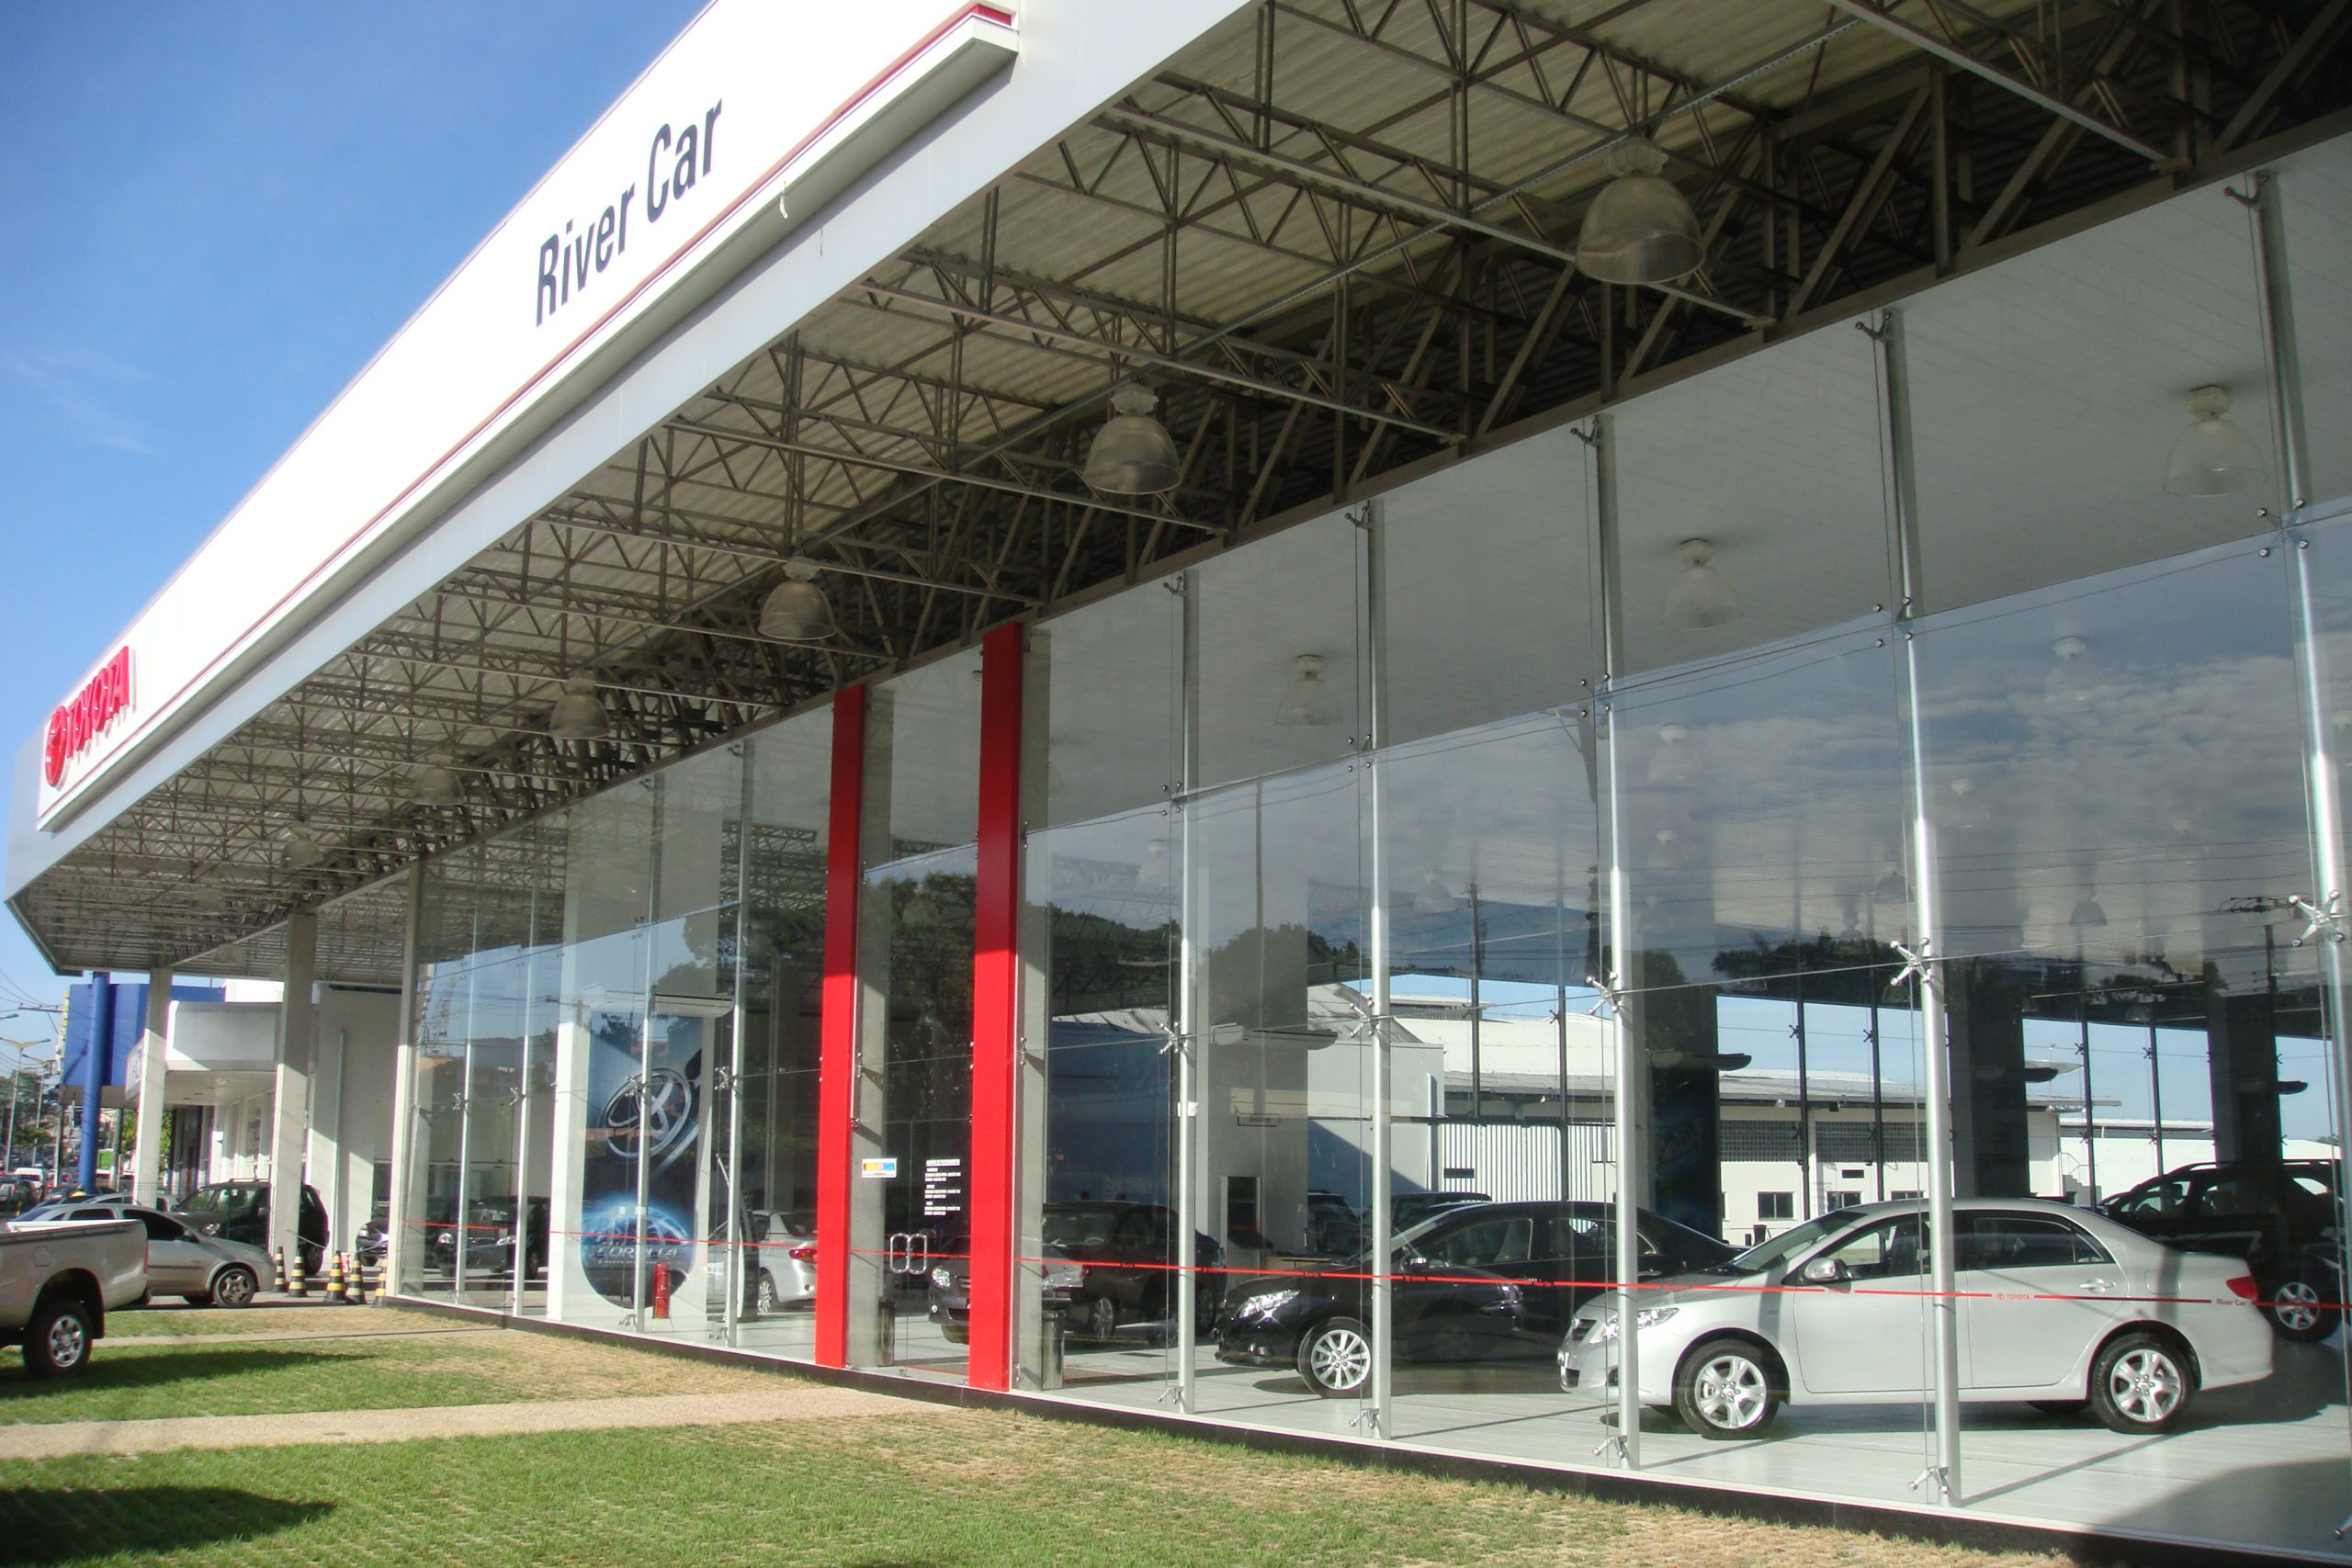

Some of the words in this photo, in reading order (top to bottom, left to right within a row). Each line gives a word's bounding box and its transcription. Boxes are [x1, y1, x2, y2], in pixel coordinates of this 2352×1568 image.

[536, 181, 636, 329] River
[646, 97, 723, 223] Car
[67, 646, 130, 759] TOYOTA
[594, 1247, 678, 1258] CORLLA
